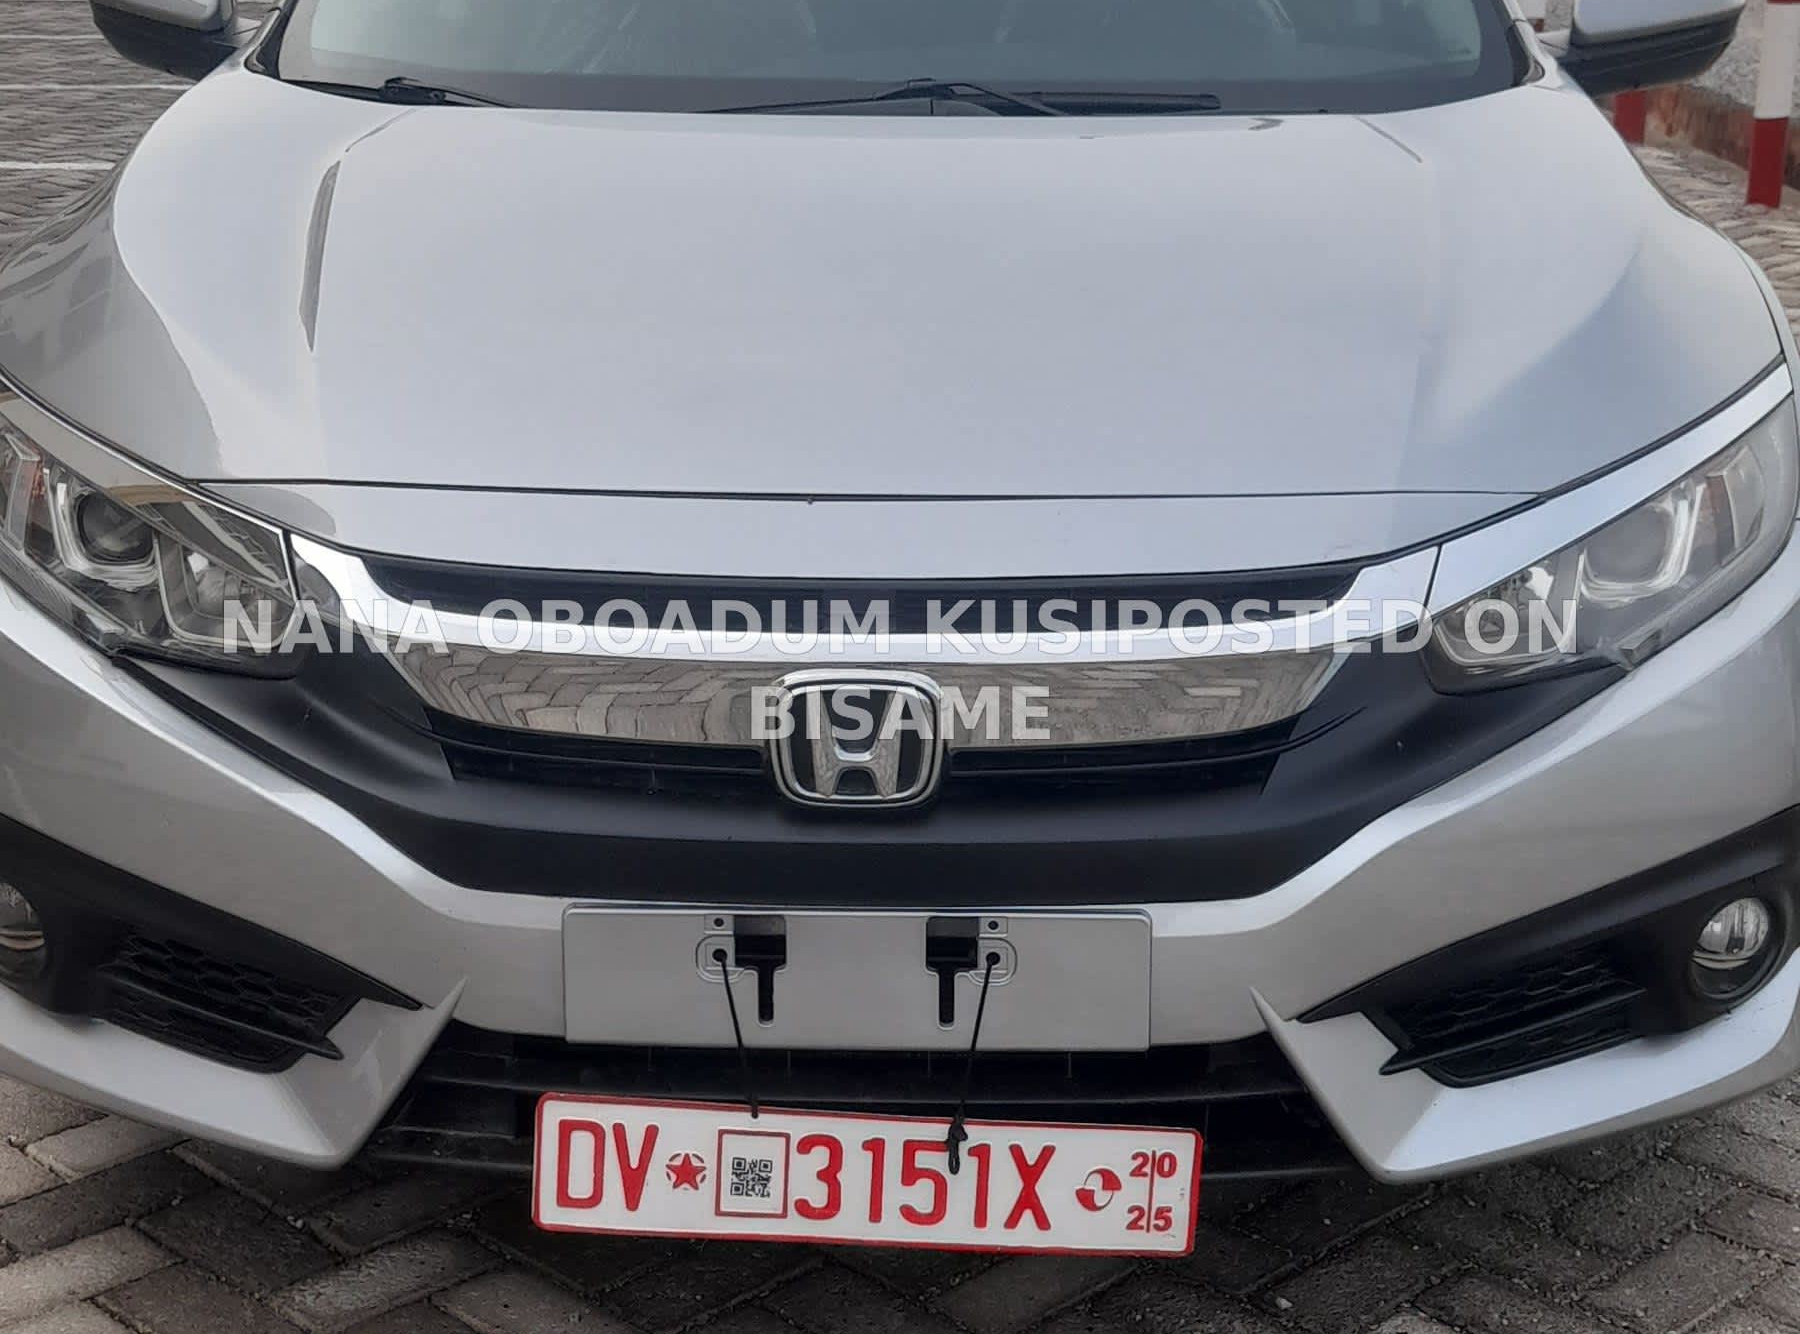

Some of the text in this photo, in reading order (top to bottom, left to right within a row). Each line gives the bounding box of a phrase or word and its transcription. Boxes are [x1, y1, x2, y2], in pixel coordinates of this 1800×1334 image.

[557, 1118, 1057, 1232] DV 3151X
[1129, 1151, 1178, 1178] 20
[1125, 1205, 1173, 1232] 25
